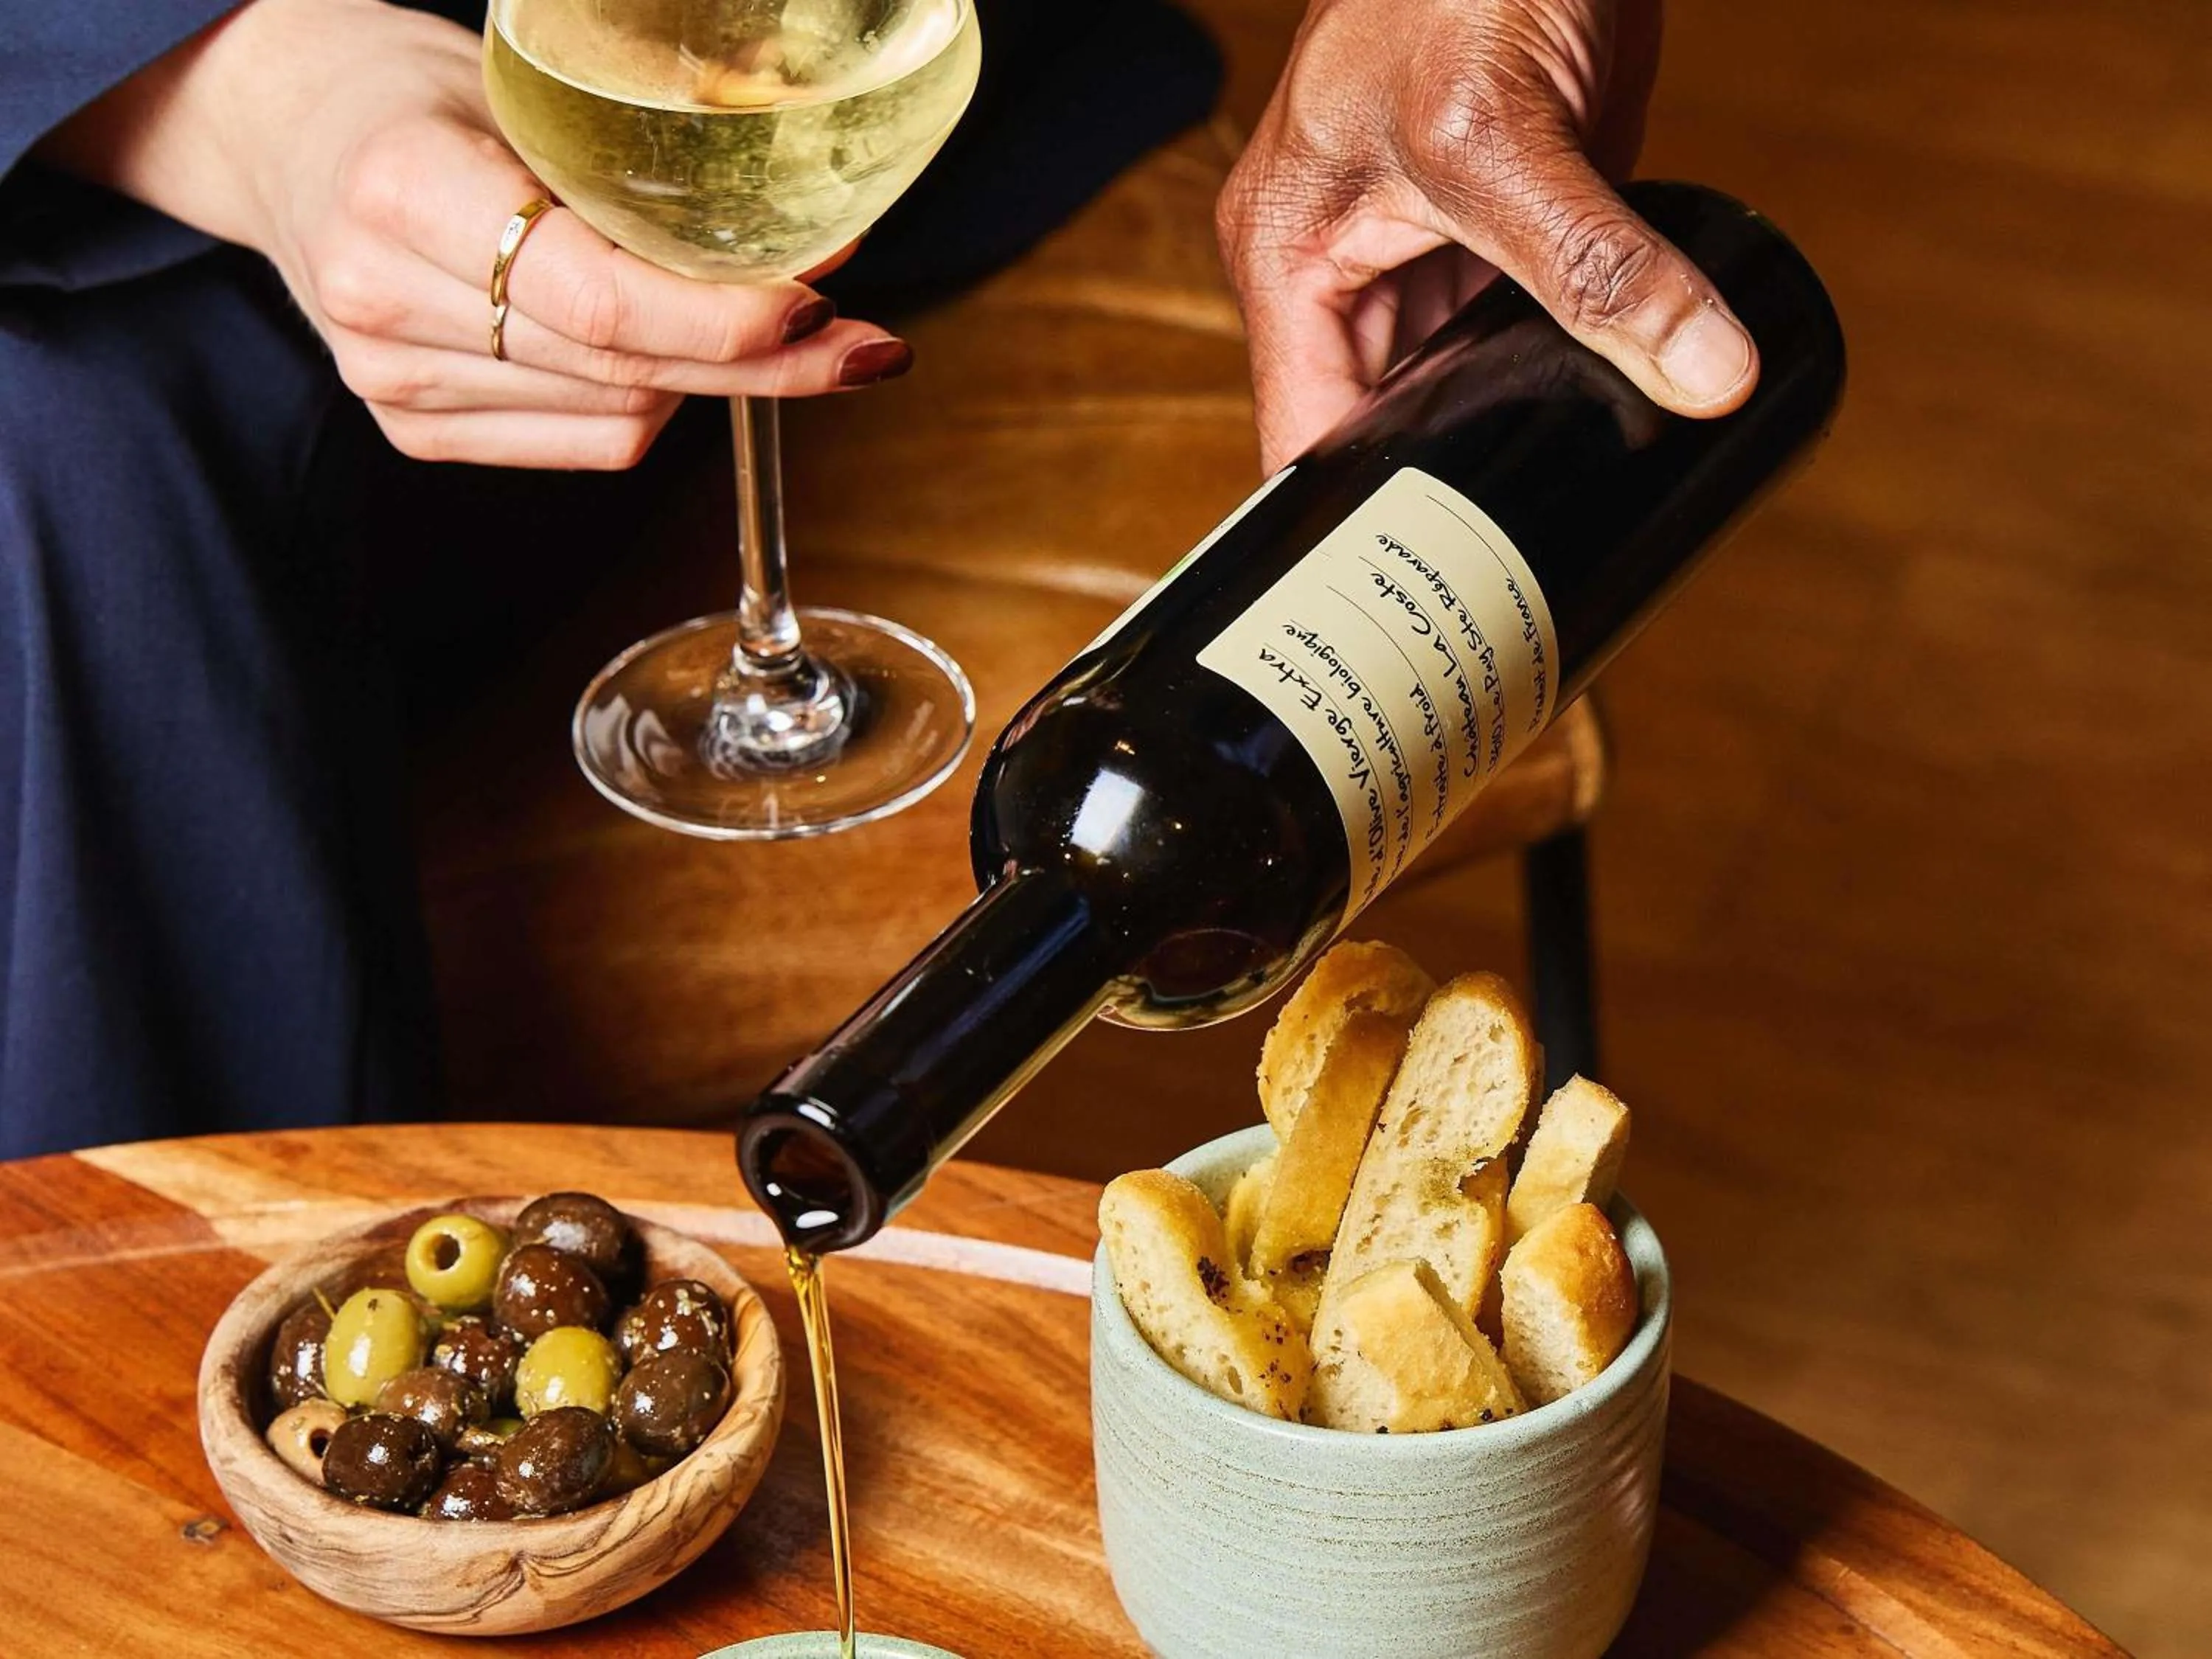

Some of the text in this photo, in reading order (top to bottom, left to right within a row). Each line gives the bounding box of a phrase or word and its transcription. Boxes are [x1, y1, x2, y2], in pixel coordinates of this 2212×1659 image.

[1371, 573, 1431, 635] Coste
[1376, 535, 1456, 611] Réparade
[1458, 609, 1482, 650] Ste
[1506, 577, 1537, 643] France
[1259, 648, 1323, 712] Extra
[1281, 625, 1362, 700] biologique
[1433, 633, 1458, 678] La
[1479, 646, 1499, 693] Puy
[1409, 683, 1439, 736] froid
[1325, 709, 1371, 790] Vierge
[1368, 788, 1384, 862] d'Olive
